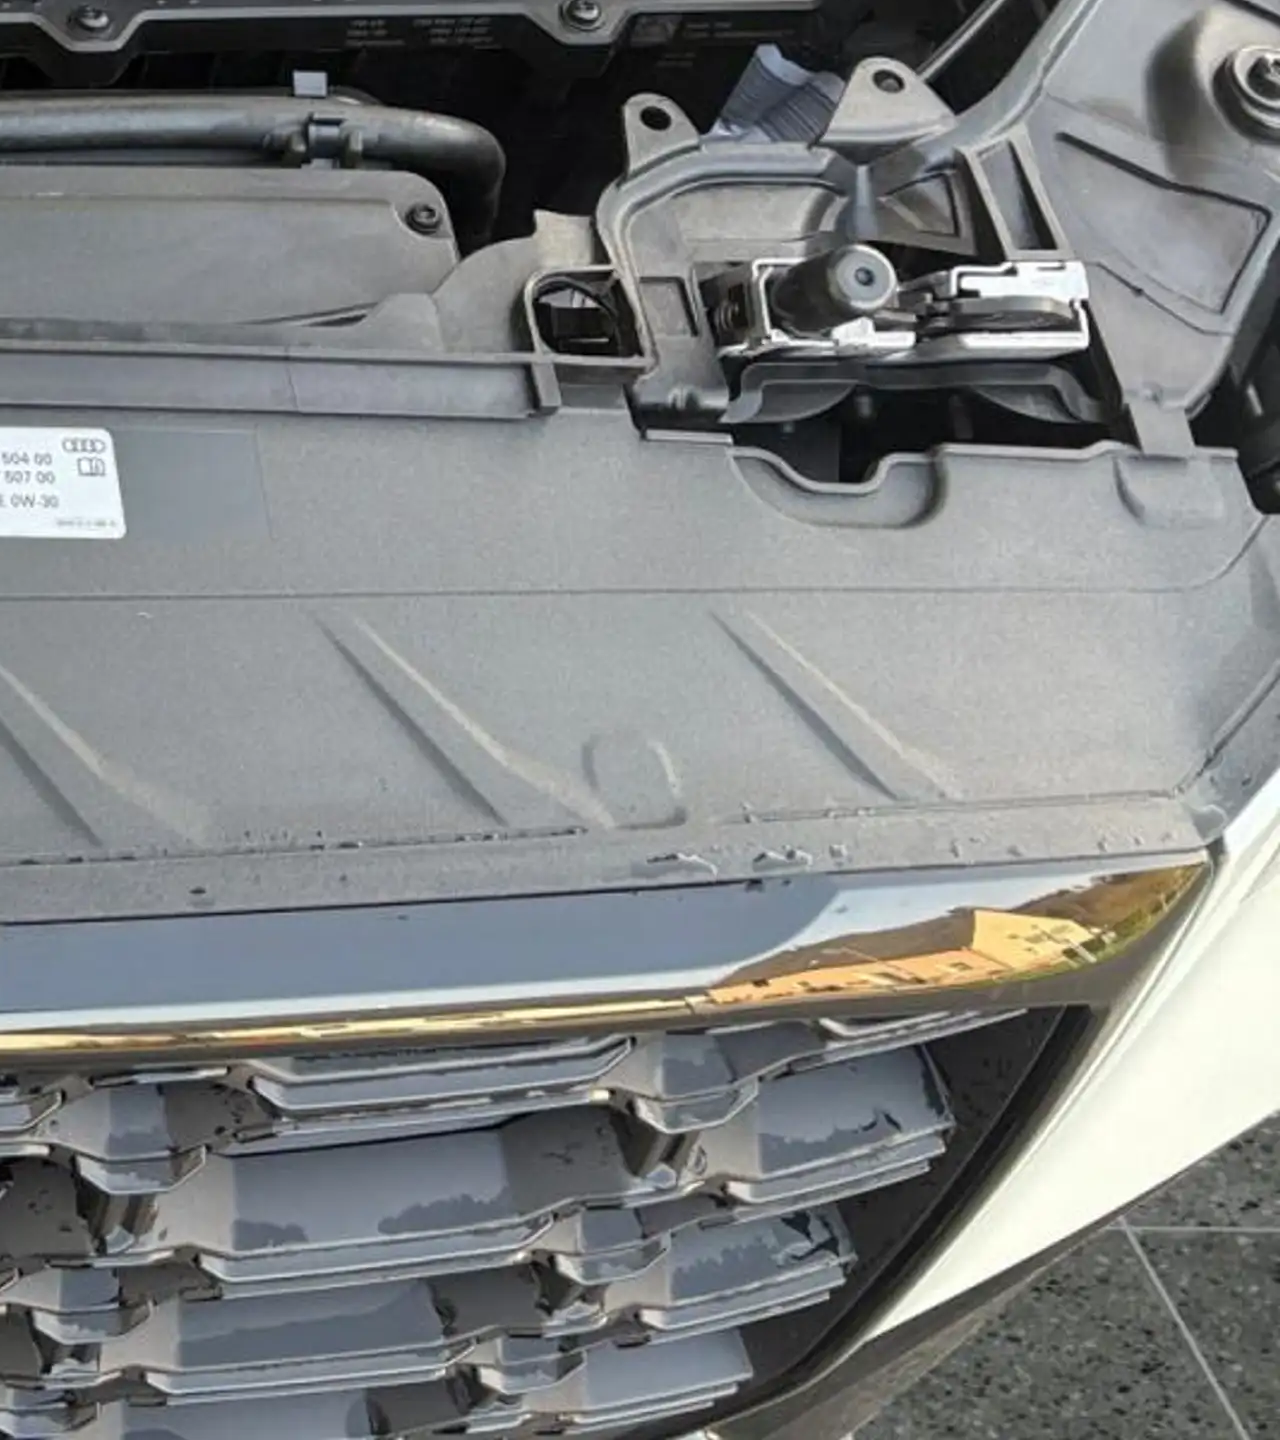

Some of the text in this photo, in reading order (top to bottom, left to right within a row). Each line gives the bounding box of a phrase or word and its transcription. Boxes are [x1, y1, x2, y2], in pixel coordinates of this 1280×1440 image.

[2, 452, 30, 466] 504
[34, 453, 53, 466] 00
[5, 471, 31, 484] 507
[36, 471, 56, 485] 00
